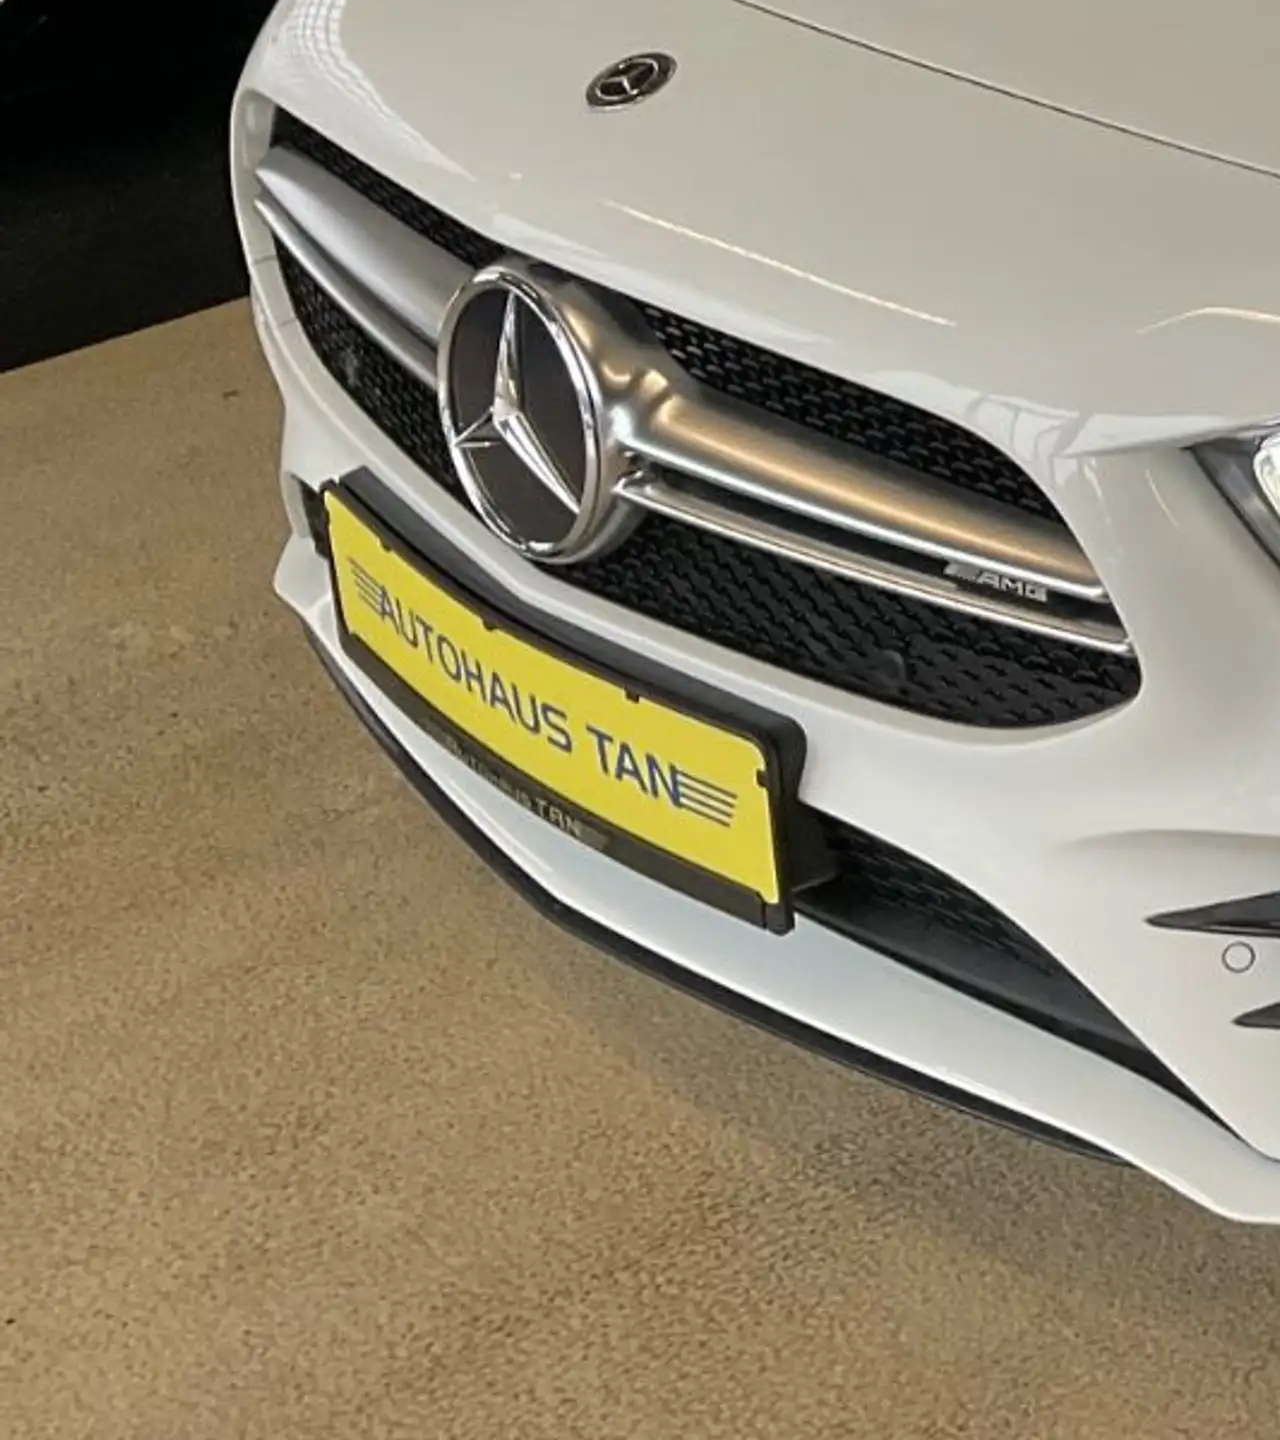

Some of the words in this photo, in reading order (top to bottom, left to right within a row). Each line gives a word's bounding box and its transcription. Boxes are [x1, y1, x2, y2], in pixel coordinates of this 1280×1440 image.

[977, 571, 1048, 602] AMG
[379, 584, 573, 754] AUTOHAUS
[586, 722, 684, 808] TAN
